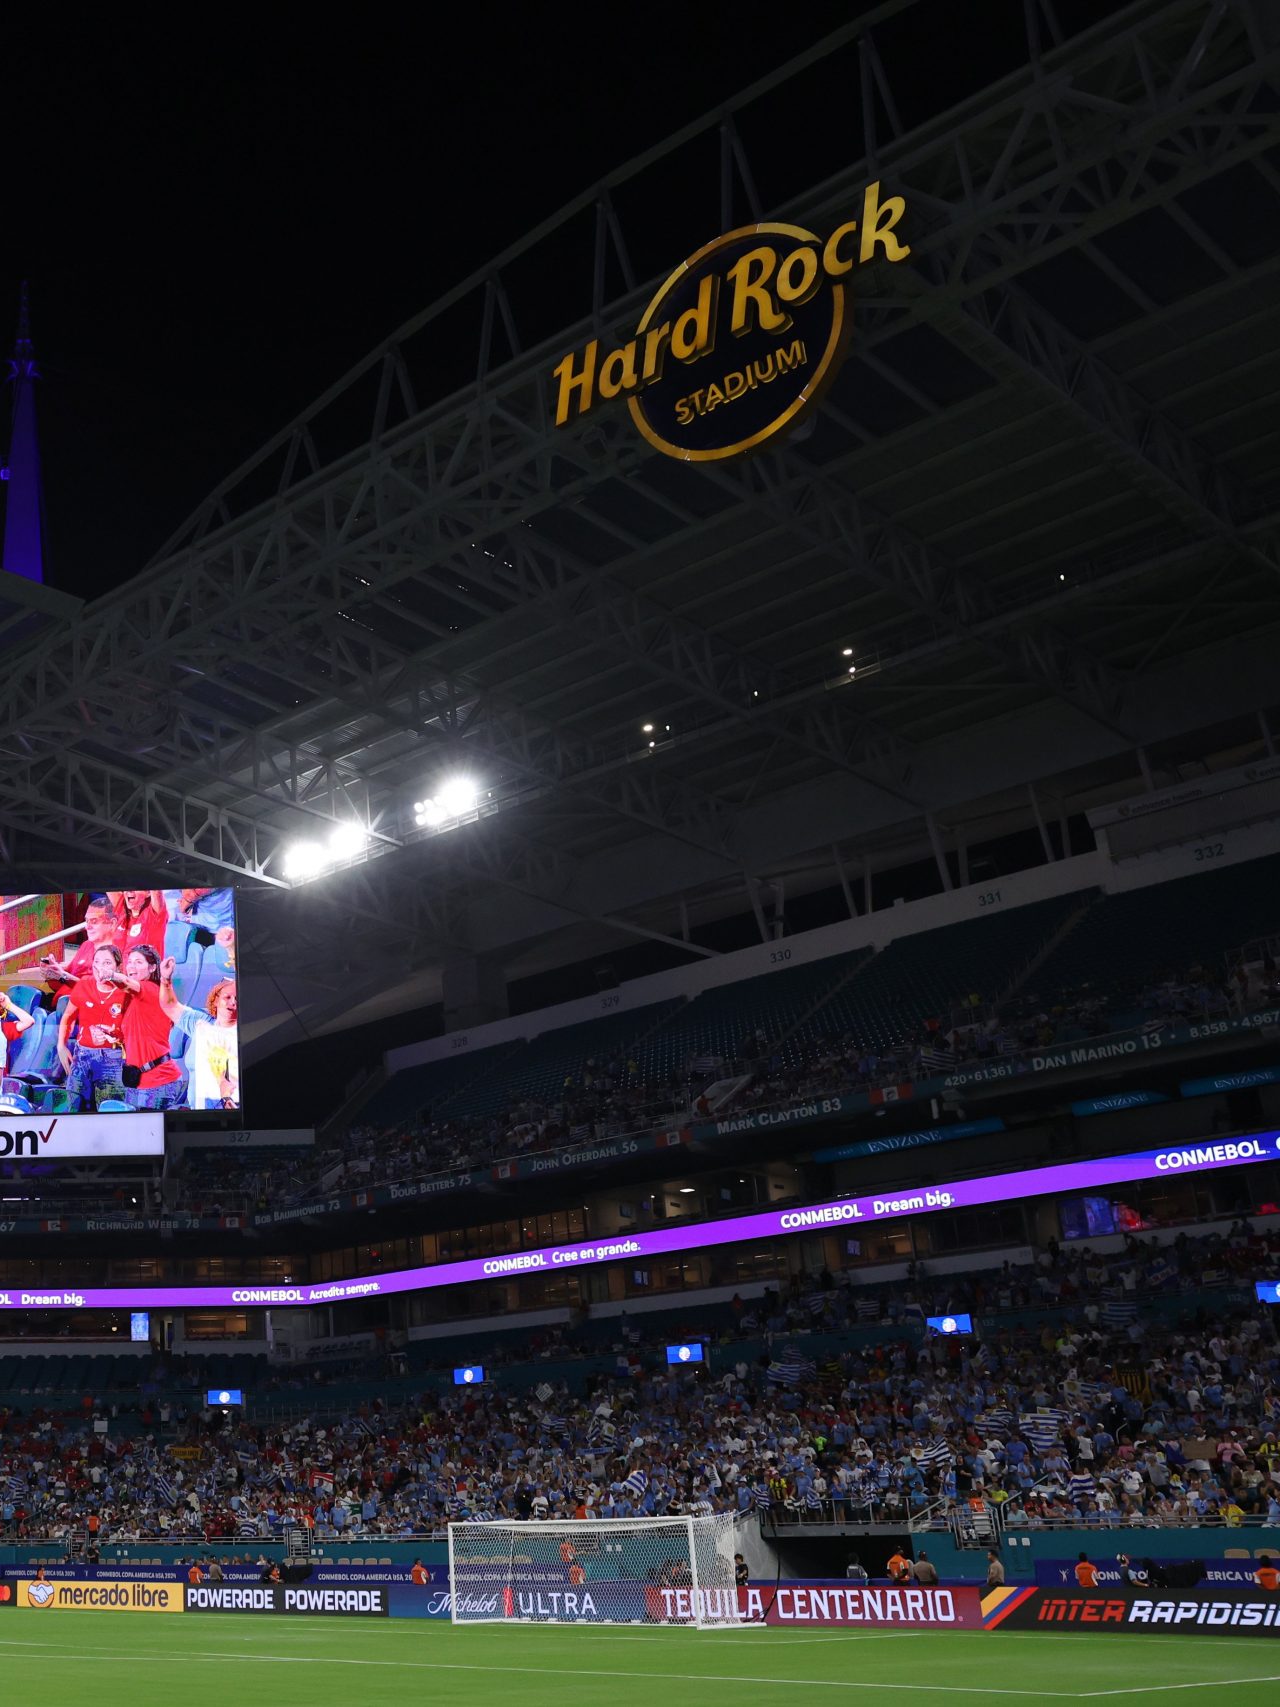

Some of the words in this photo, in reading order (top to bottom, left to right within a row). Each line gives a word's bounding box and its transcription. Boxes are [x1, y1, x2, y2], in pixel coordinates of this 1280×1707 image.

[553, 274, 720, 427] Hard
[727, 180, 911, 337] Rock
[675, 340, 808, 425] STADIUM
[1194, 843, 1224, 862] 332
[978, 890, 1002, 906] 331
[770, 949, 792, 963] 330
[451, 1036, 468, 1049] 328
[944, 1075, 967, 1088] 420
[1032, 1055, 1067, 1072] DAN
[1070, 1040, 1137, 1064] MARINO
[1140, 1033, 1162, 1050] 13
[717, 1117, 755, 1135] MARK
[758, 1104, 818, 1125] CLAYTON
[822, 1097, 842, 1113] 83
[229, 1132, 251, 1143] 327
[868, 1129, 943, 1154] ENDZONE
[531, 1157, 559, 1172] JOHN
[562, 1146, 619, 1166] OFFERDAHL
[622, 1141, 638, 1154] 56
[391, 1185, 418, 1200] DOUG
[420, 1179, 456, 1194] BETTERS
[458, 1175, 471, 1187] 75
[255, 1214, 272, 1226] BOB
[274, 1203, 325, 1221] BAUMHOWER
[328, 1200, 341, 1212] 73
[873, 1195, 924, 1215] Dream
[925, 1189, 955, 1209] big.
[0, 1221, 17, 1233] 67
[86, 1219, 144, 1231] RICHMOND
[148, 1218, 179, 1230] WEBB
[185, 1218, 200, 1230] 78
[551, 1247, 578, 1263] Cree
[580, 1247, 594, 1259] en
[596, 1240, 641, 1261] grande.
[21, 1293, 62, 1306] Dream
[63, 1292, 86, 1308] big.
[309, 1286, 345, 1300] Acredite
[345, 1281, 381, 1296] sempre.
[228, 1573, 243, 1581] COPA
[318, 1573, 350, 1581] CONMEBOL
[350, 1573, 365, 1581] COPA
[365, 1573, 392, 1581] AMERICA
[392, 1573, 404, 1582] USA
[405, 1574, 413, 1582] 20
[1206, 1570, 1243, 1581] ERICA
[59, 1584, 129, 1606] mercado
[132, 1584, 168, 1608] libre
[187, 1588, 275, 1610] POWERADE
[285, 1590, 383, 1612] POWERADE
[519, 1592, 598, 1615] ULTRA
[777, 1589, 956, 1622] CENTENARIO
[1128, 1600, 1280, 1627] RAPIDISI
